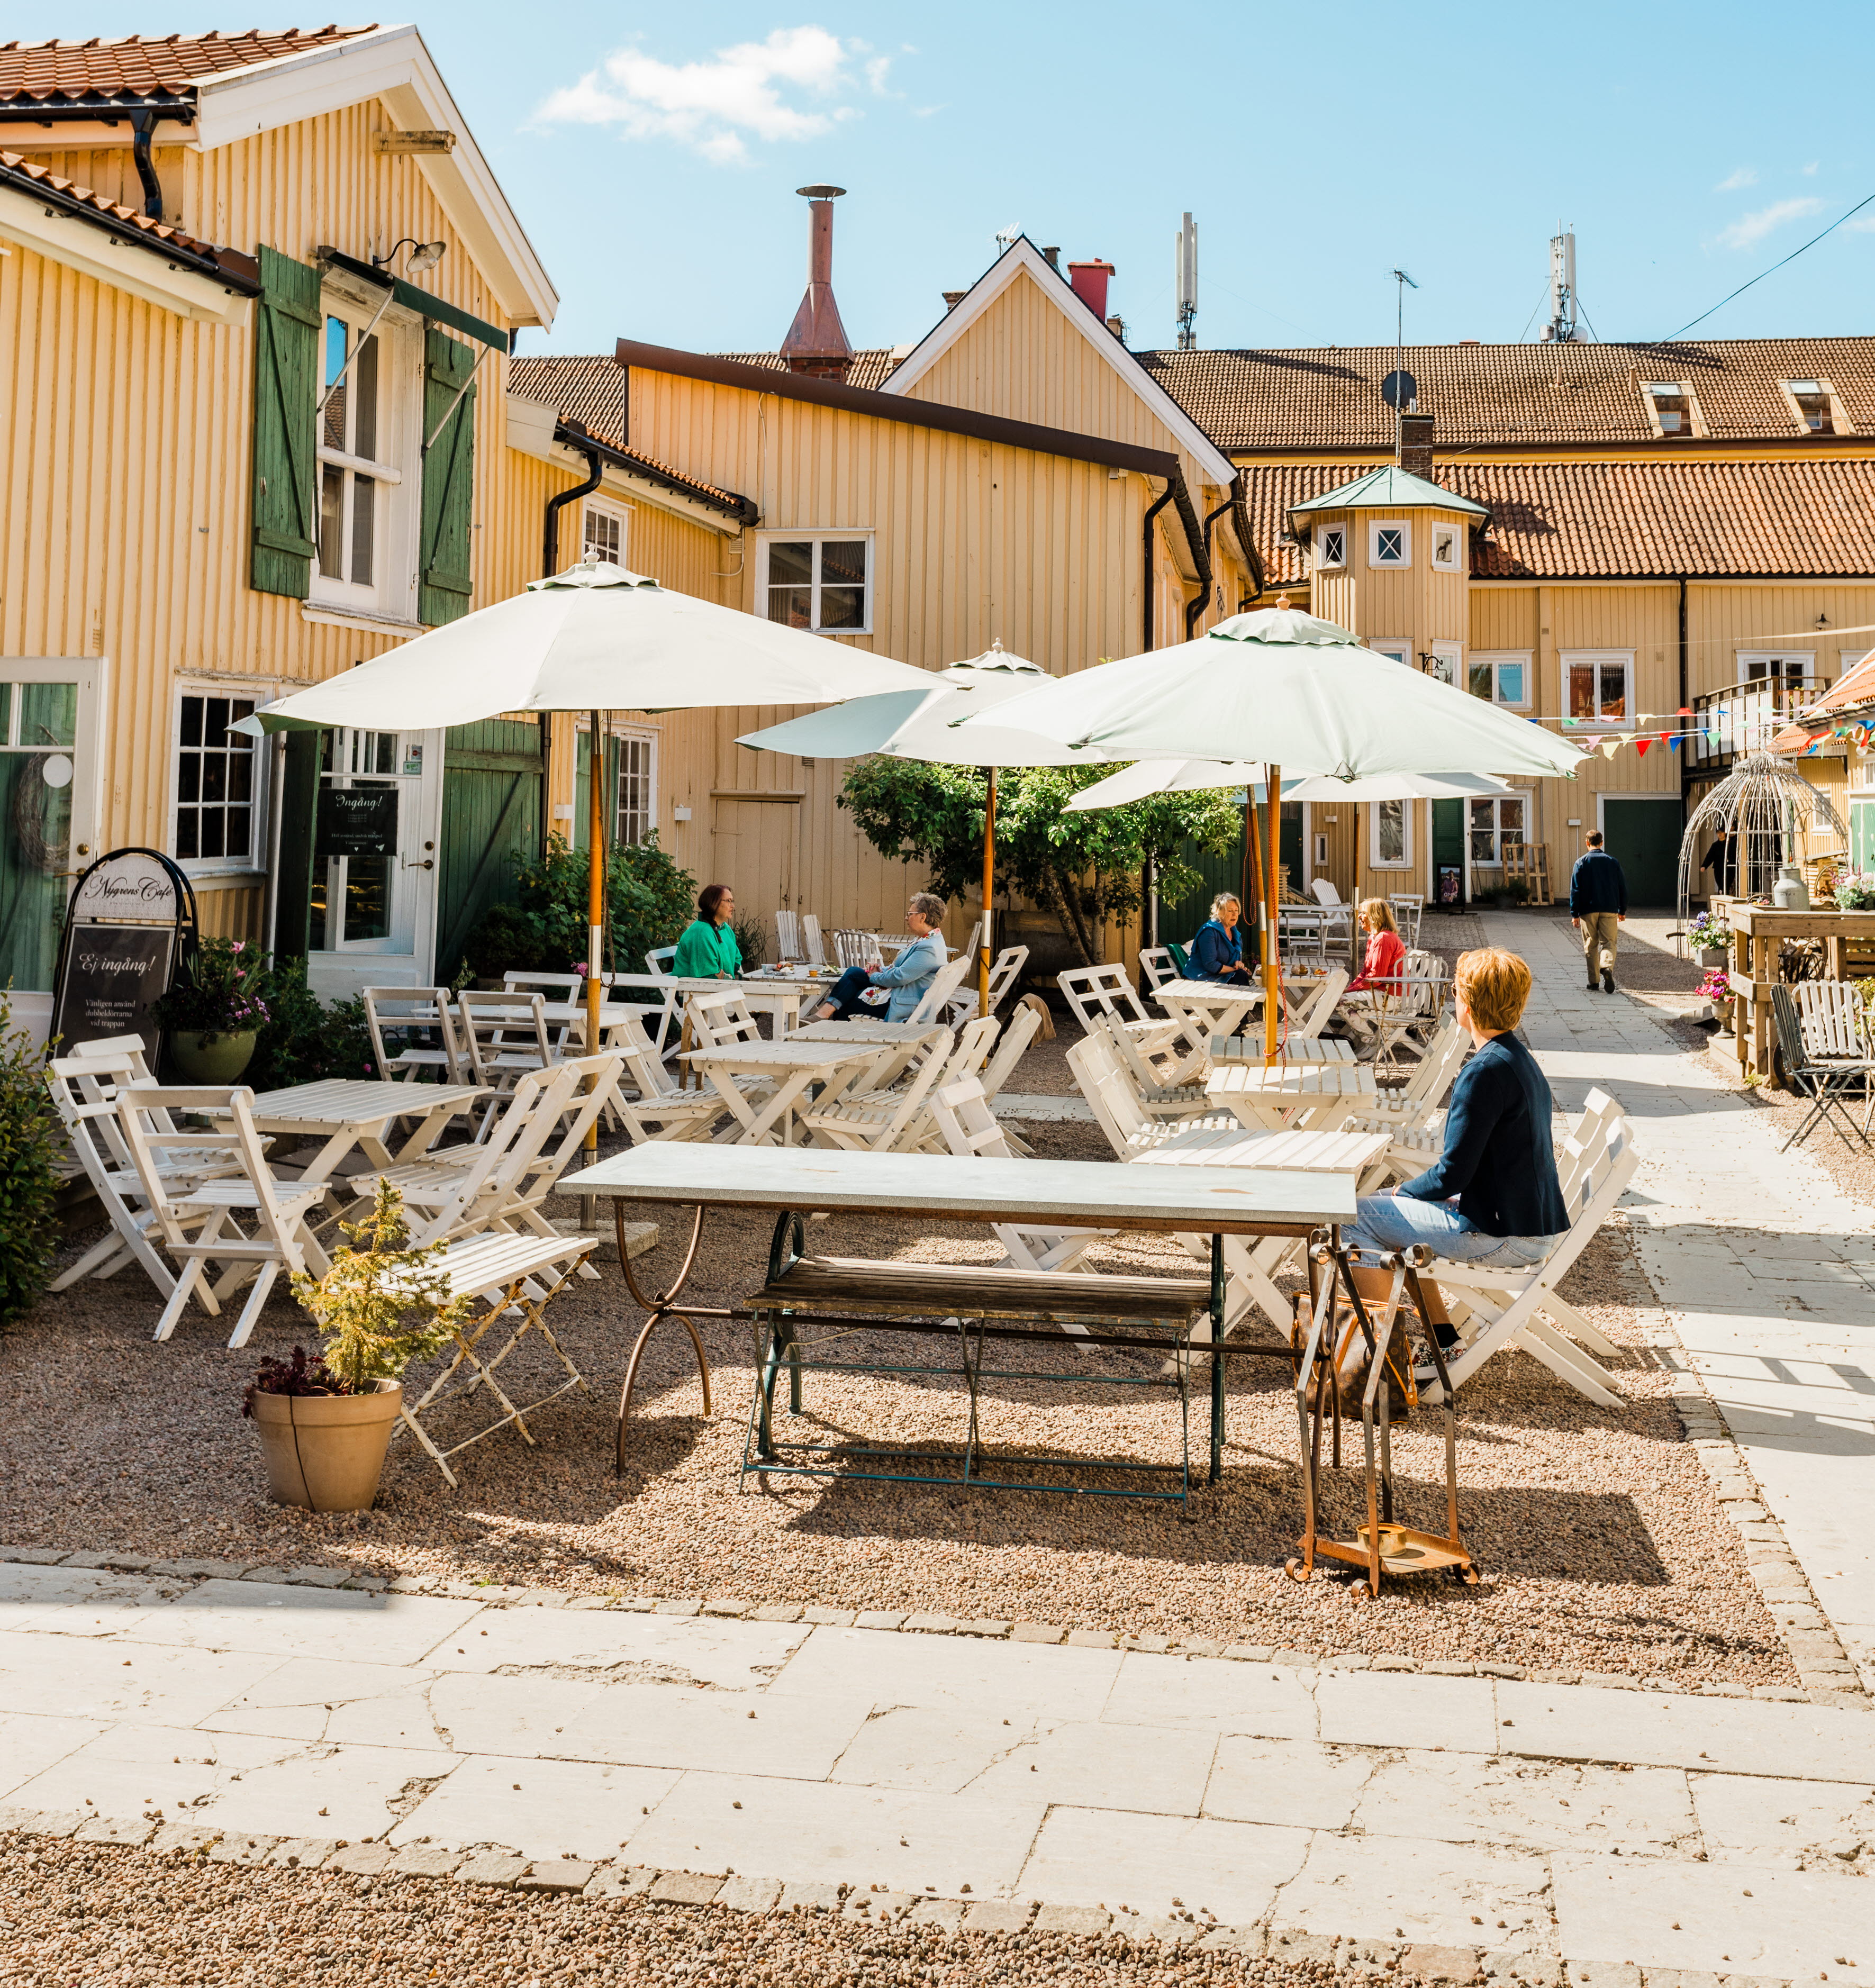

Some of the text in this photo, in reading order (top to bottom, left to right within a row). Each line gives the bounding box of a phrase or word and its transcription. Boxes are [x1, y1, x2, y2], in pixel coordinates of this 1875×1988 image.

[336, 794, 383, 811] Ingång!
[85, 875, 173, 901] Nygrens Café
[79, 954, 156, 976] Ej ingång!
[86, 999, 112, 1009] Vänligen
[101, 1020, 125, 1029] trappan
